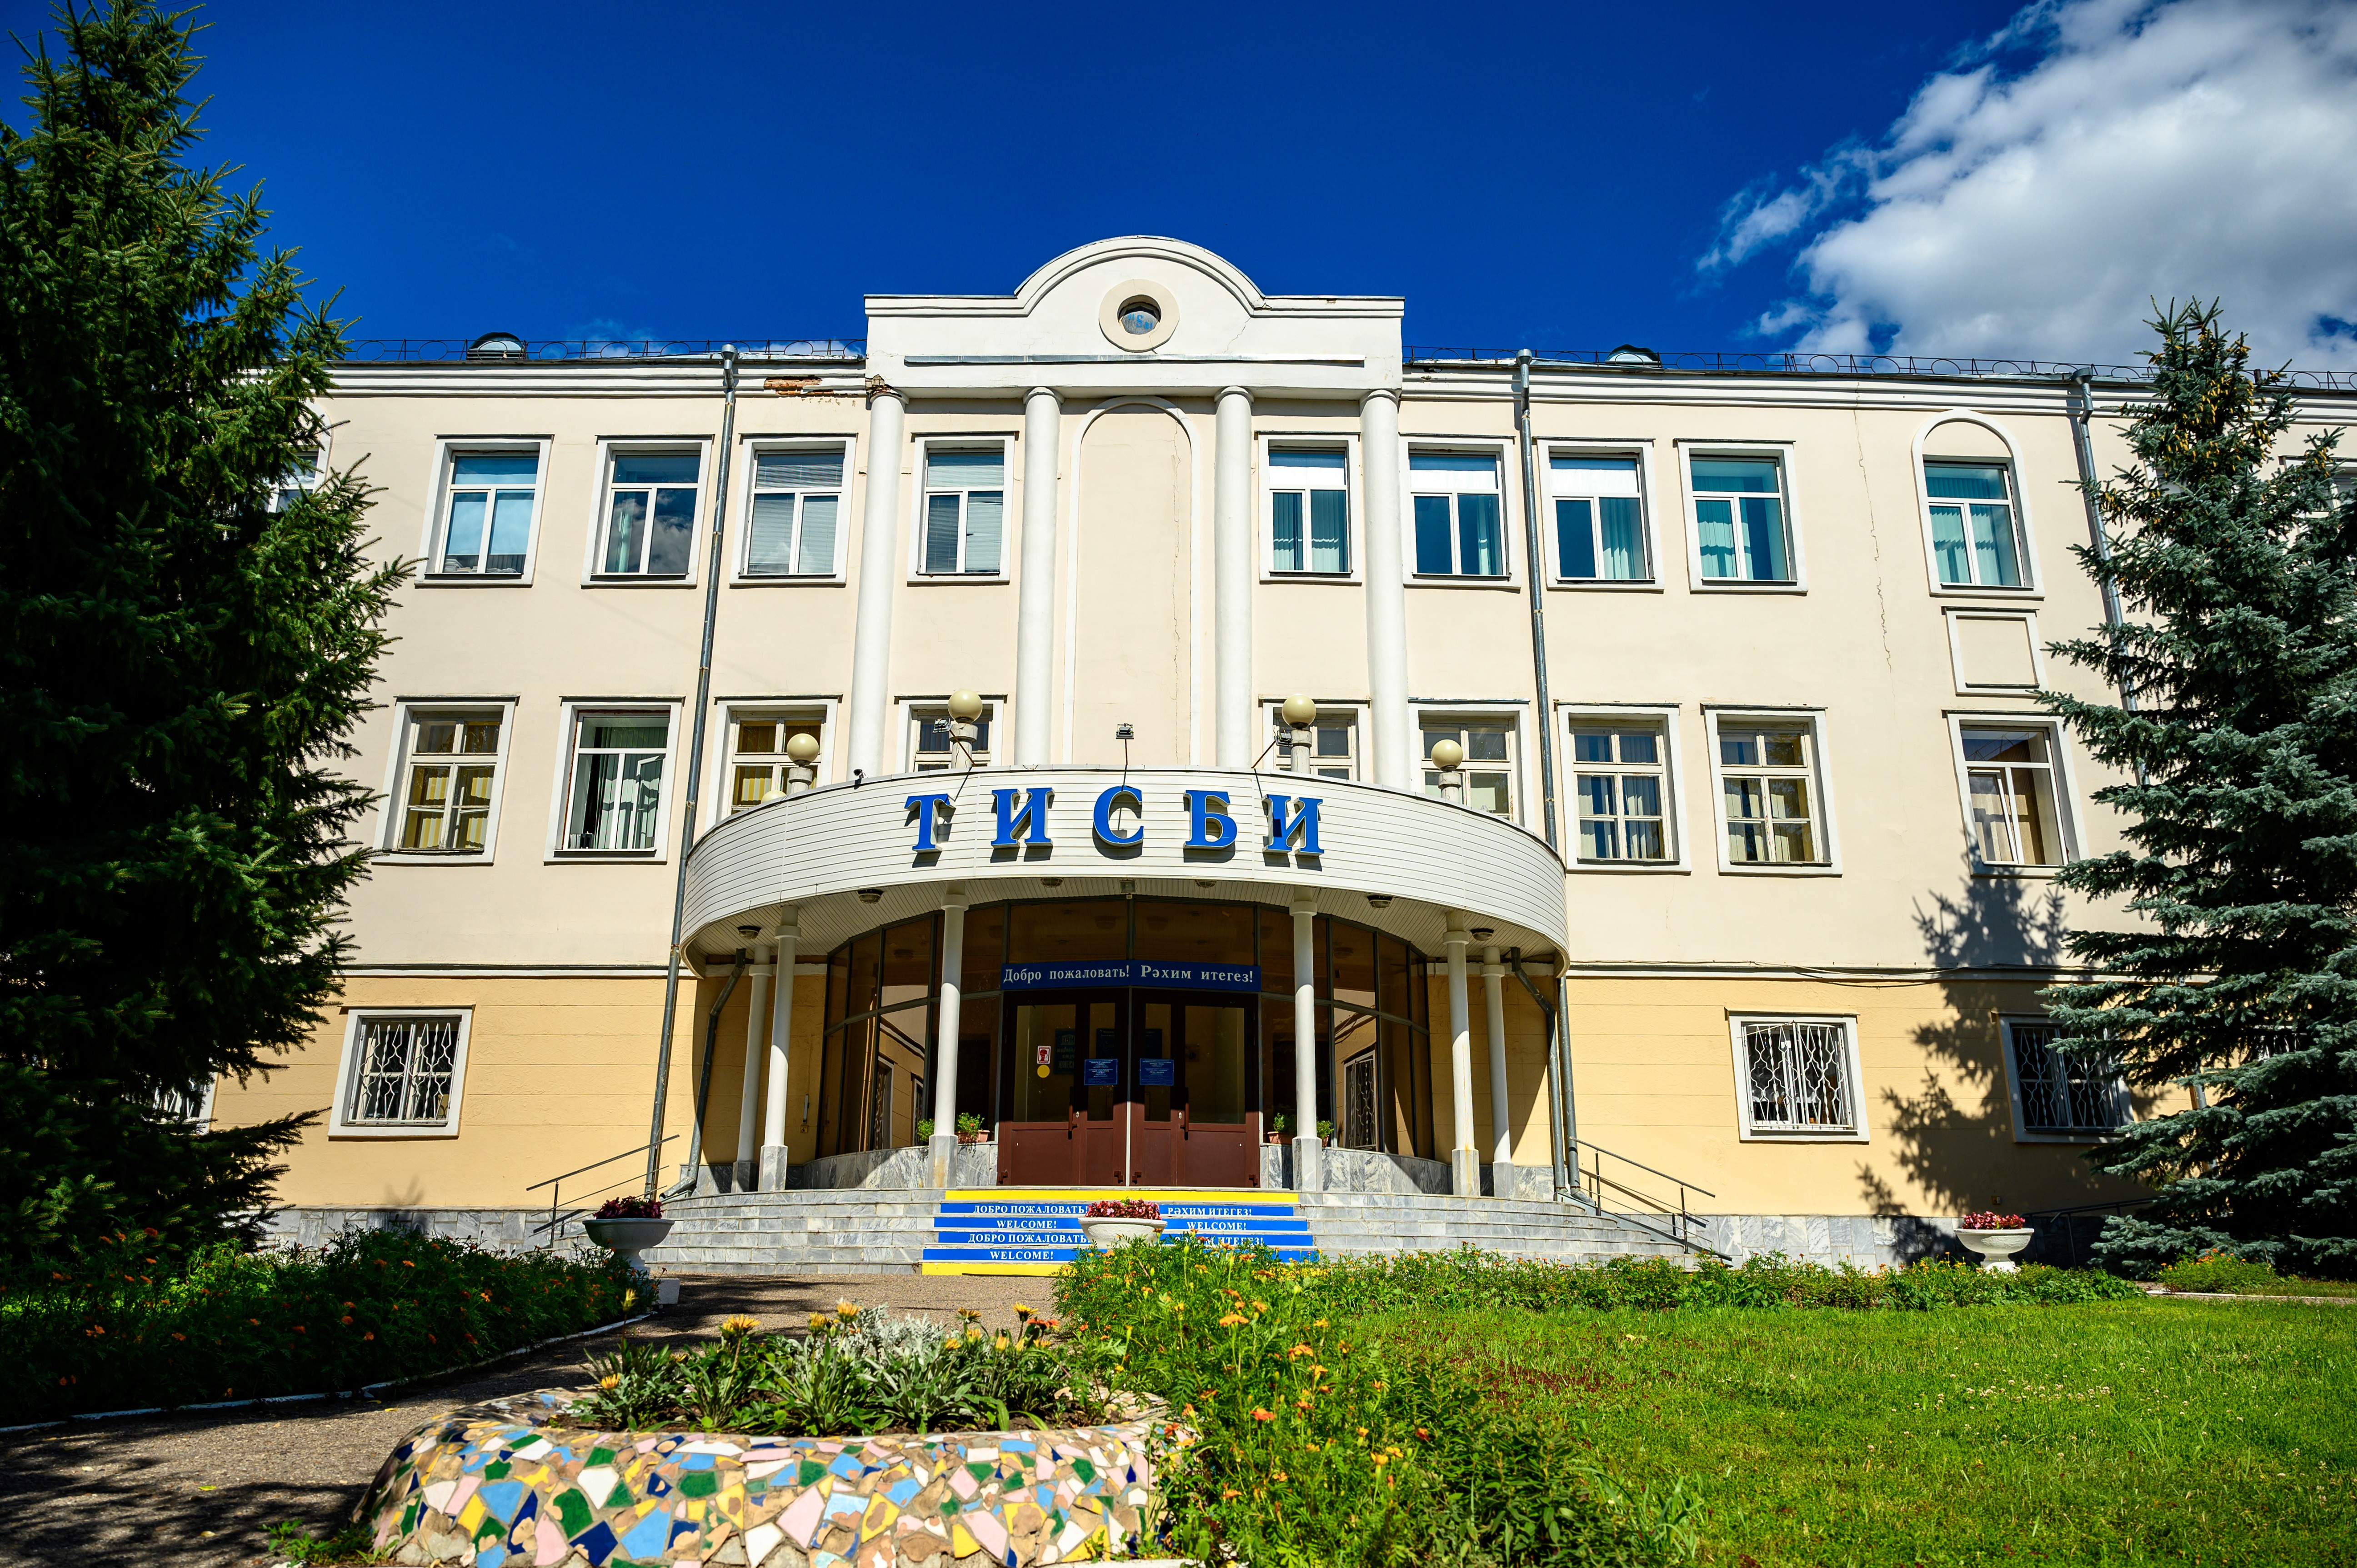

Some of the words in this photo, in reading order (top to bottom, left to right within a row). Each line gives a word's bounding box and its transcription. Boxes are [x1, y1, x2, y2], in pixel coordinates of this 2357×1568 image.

[904, 785, 1325, 855] ТИСБИ
[1003, 969, 1041, 984] Добро
[1050, 965, 1129, 979] пожаловать!
[1141, 965, 1191, 979] Рәхим
[1201, 971, 1253, 983] итегез!
[973, 1205, 1008, 1213] ДОБРО
[1011, 1205, 1088, 1213] ПОЖАЛОВАТЬ!
[1168, 1207, 1206, 1215] РӘХИМ
[996, 1220, 1057, 1228] WELCOME!
[1187, 1221, 1246, 1230] WELCOME!
[968, 1234, 1005, 1243] ДОБРО
[990, 1251, 1053, 1259] WELCOME!
